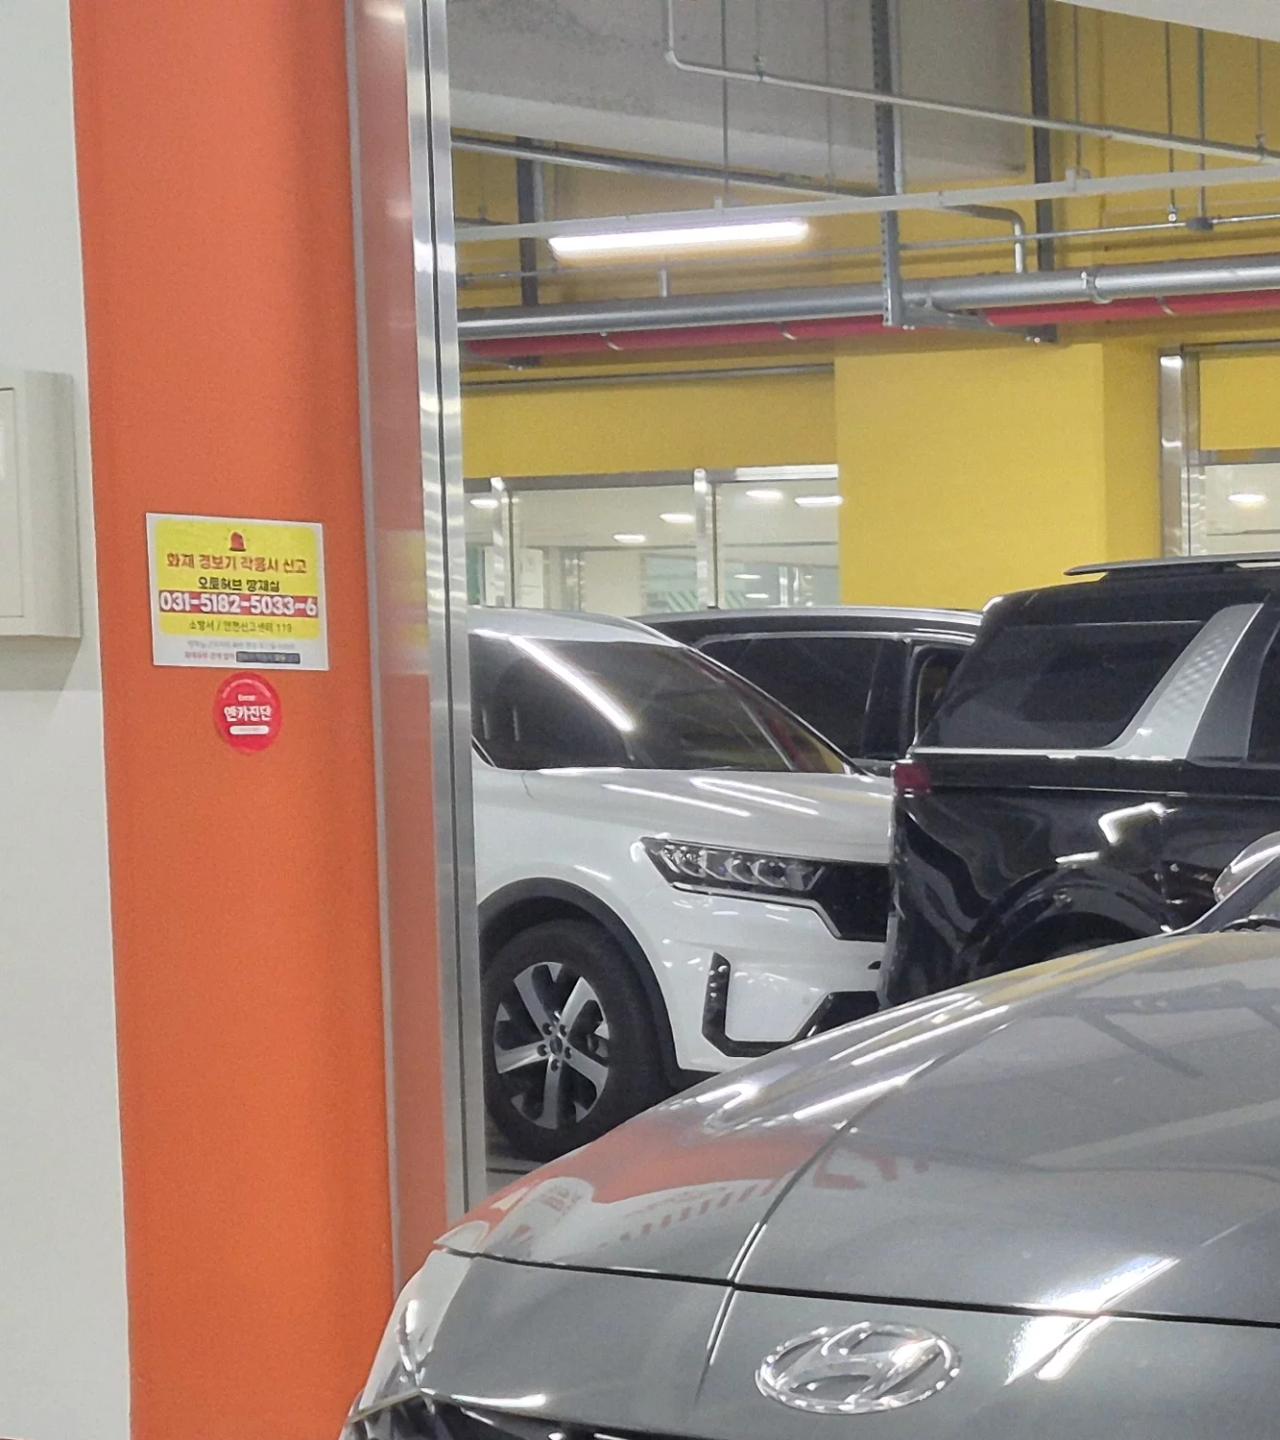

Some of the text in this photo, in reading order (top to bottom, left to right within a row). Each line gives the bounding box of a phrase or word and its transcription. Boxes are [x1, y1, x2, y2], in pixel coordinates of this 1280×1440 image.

[167, 553, 195, 569] 화재
[200, 554, 237, 571] 경보기
[283, 559, 307, 574] 신고
[276, 623, 292, 633] 119
